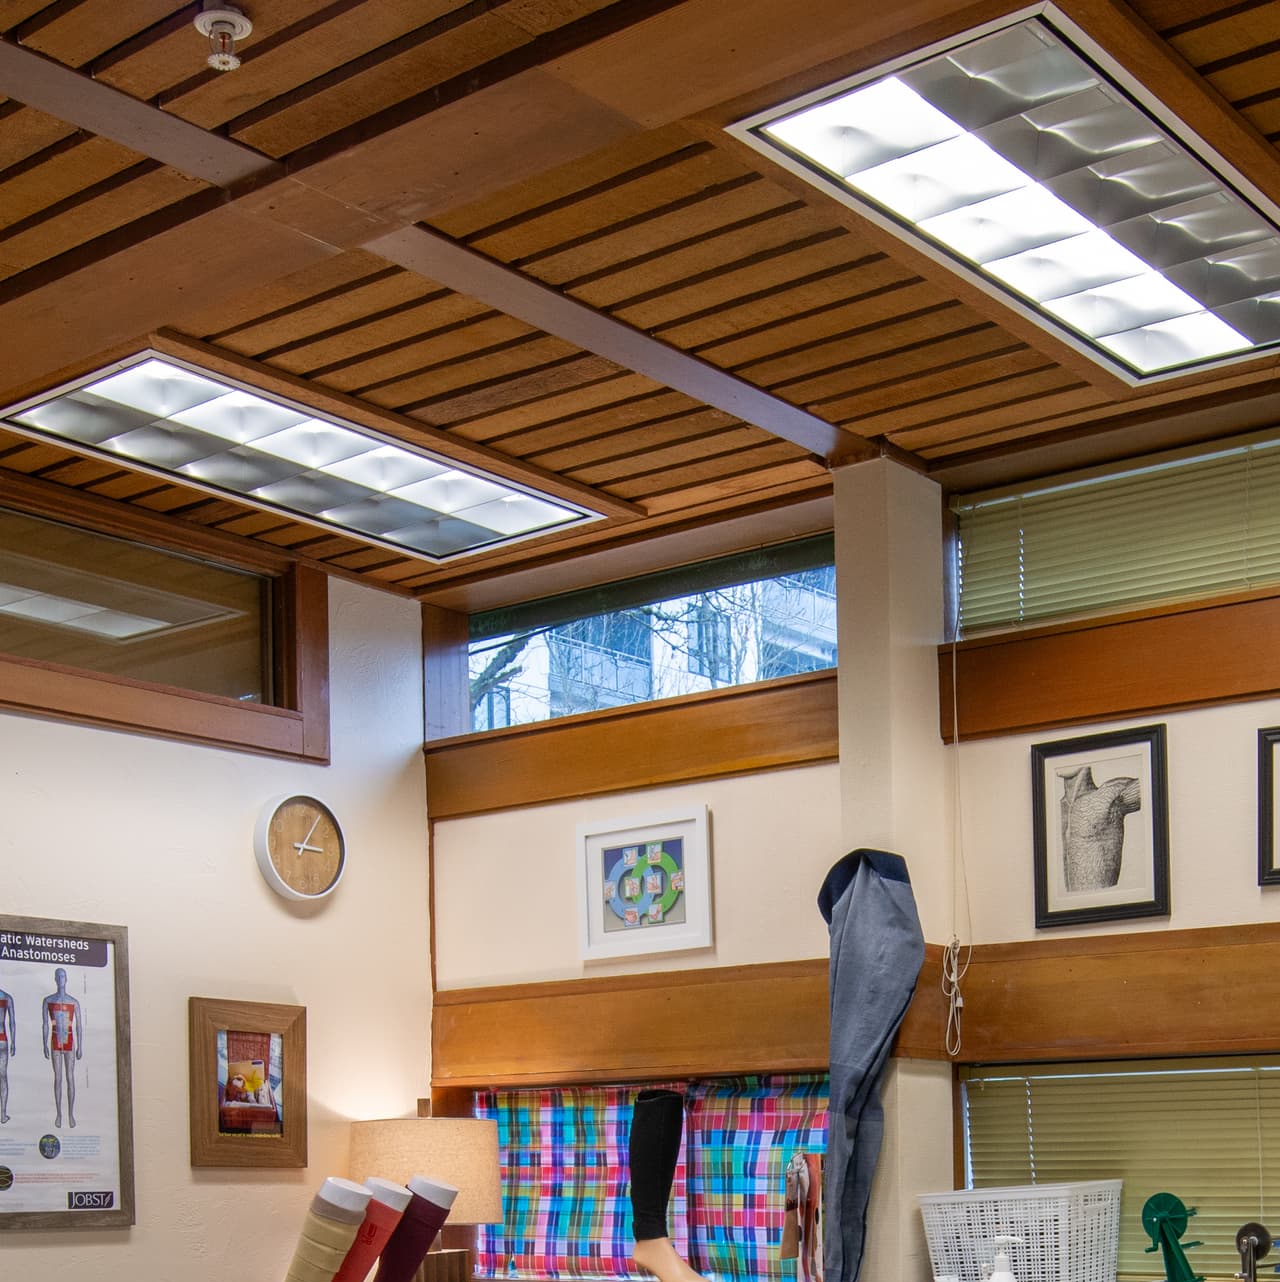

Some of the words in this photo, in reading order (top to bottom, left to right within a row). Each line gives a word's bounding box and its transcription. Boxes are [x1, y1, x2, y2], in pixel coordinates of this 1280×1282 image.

[25, 935, 90, 951] Watersheds
[1, 946, 77, 963] Anastomoses
[72, 1192, 107, 1209] JOBST
